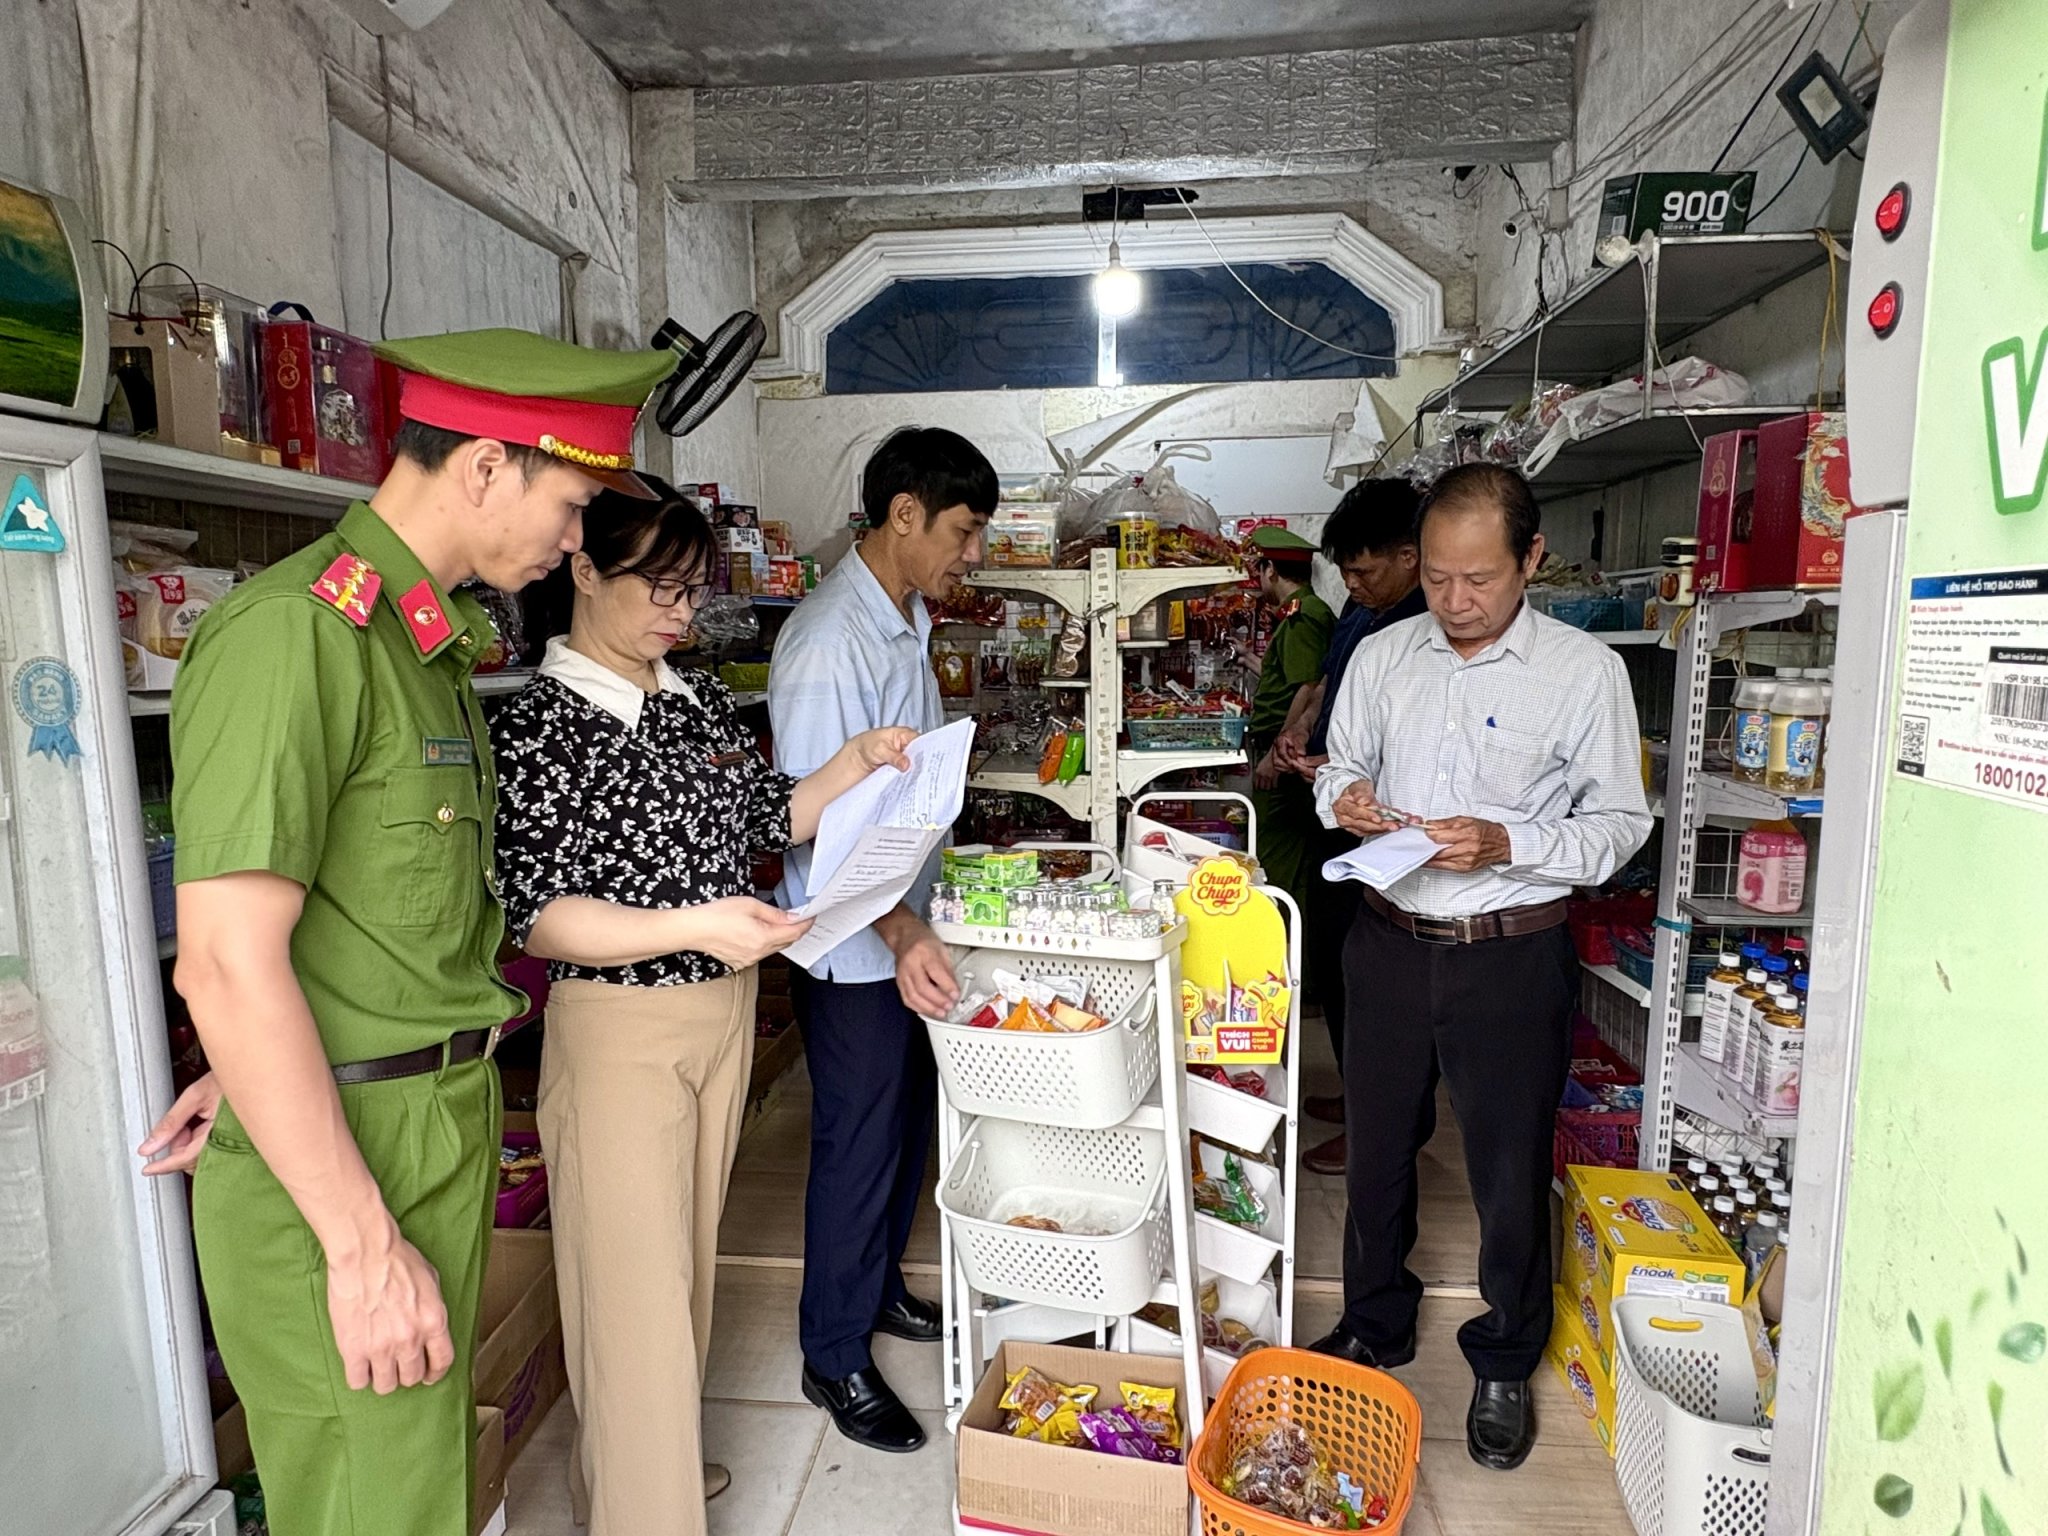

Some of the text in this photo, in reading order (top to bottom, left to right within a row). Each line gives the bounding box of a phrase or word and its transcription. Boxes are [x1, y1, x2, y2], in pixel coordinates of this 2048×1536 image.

[1661, 190, 1730, 221] 900
[1945, 580, 1961, 593] LIÊN
[1983, 580, 1997, 594] TRỢ
[36, 685, 57, 698] 24
[1974, 762, 2048, 797] 1800102
[1199, 872, 1242, 887] Chupa
[1197, 885, 1241, 907] Chups
[1219, 1029, 1250, 1039] THÍCH
[1220, 1039, 1251, 1051] VUI
[1631, 1265, 1676, 1279] Enaak
